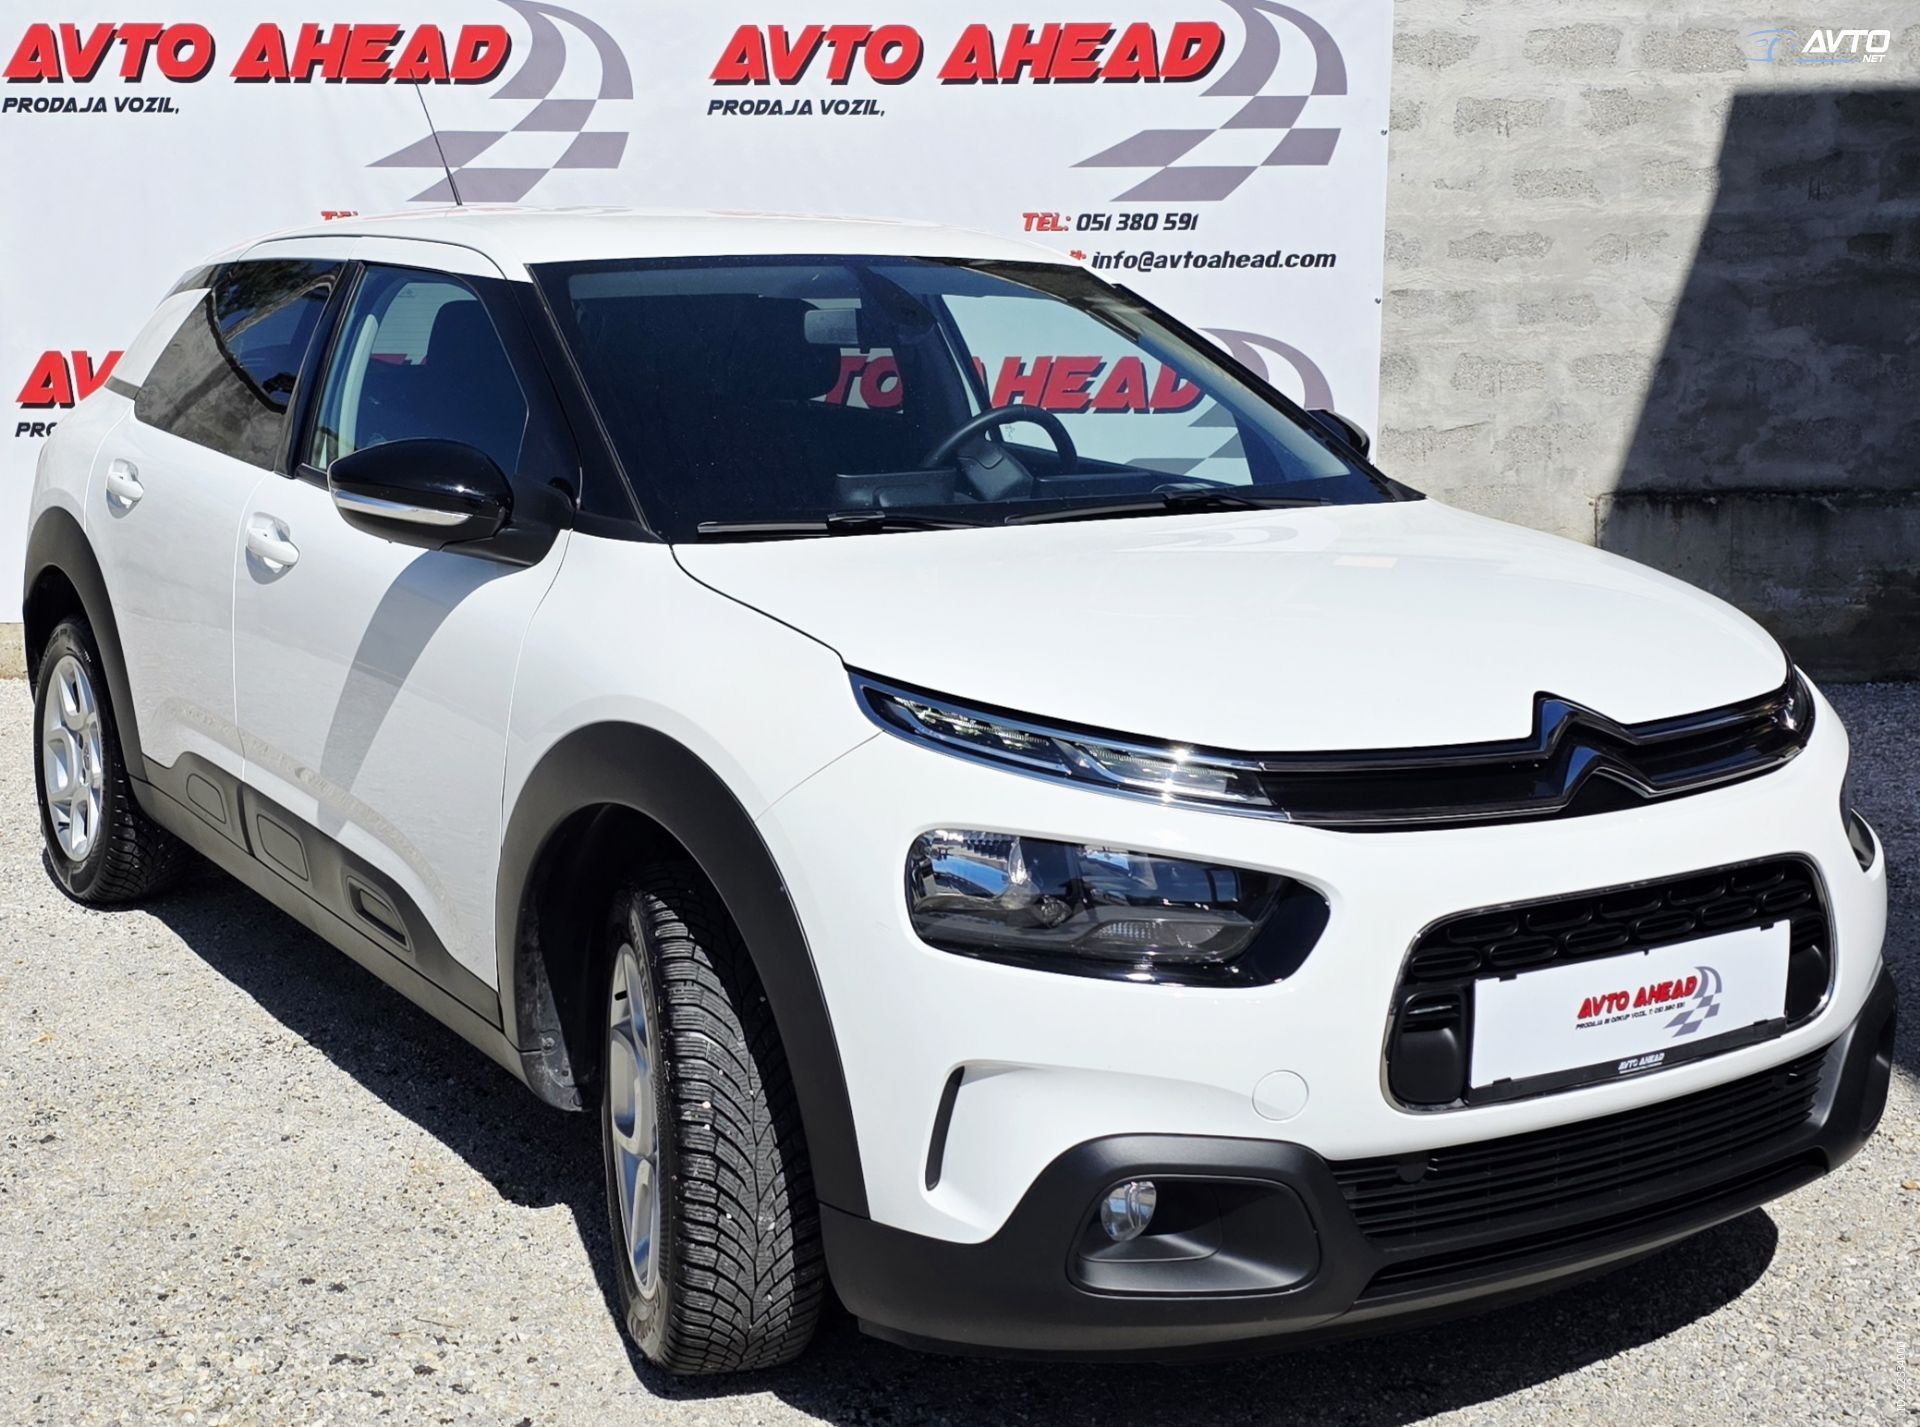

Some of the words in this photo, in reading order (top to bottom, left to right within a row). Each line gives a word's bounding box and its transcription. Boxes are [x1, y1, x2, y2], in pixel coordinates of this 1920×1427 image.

[3, 23, 216, 84] AVTO
[230, 23, 513, 85] AHEAD
[709, 24, 925, 86] AVTO
[937, 21, 1226, 84] AHEAD
[2, 96, 108, 113] PRODAJA
[114, 96, 179, 115] VOZIL,
[707, 99, 813, 116] PRODAJA
[820, 99, 885, 117] VOZIL,
[1023, 212, 1072, 232] TEL:
[1076, 213, 1113, 232] 051
[1116, 212, 1159, 231] 380
[1162, 212, 1199, 231] 591
[1090, 250, 1337, 273] info@avtoahead.com
[16, 350, 125, 409] AV
[970, 355, 1203, 414] HEAD
[1577, 991, 1630, 1019] AVTO
[1633, 976, 1697, 1008] AHEAD
